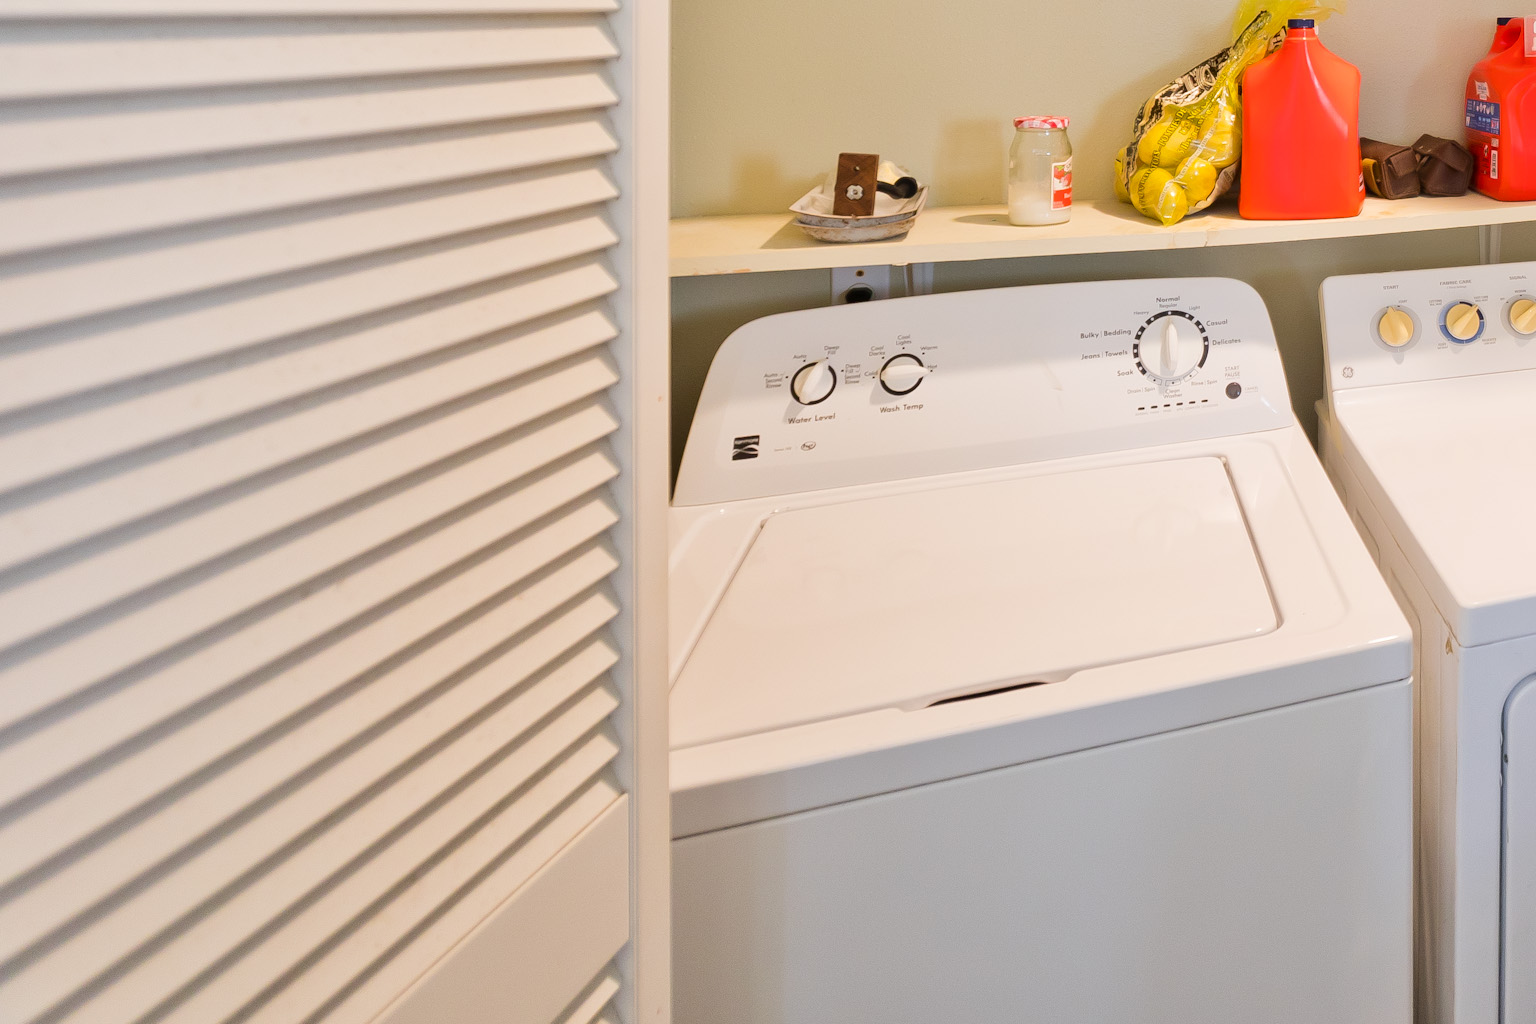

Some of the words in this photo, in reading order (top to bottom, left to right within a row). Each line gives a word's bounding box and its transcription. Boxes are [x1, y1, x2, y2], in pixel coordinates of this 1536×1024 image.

[1206, 319, 1228, 327] Casual
[1080, 331, 1099, 340] Bulky
[1103, 329, 1132, 337] Bedding
[1212, 337, 1242, 346] Delicates
[1080, 352, 1101, 361] Jeans
[1105, 349, 1128, 358] Towels
[1117, 369, 1134, 377] Soak
[879, 404, 900, 414] Wash
[903, 403, 924, 411] Temp
[788, 416, 812, 425] Water
[814, 412, 836, 422] Level
